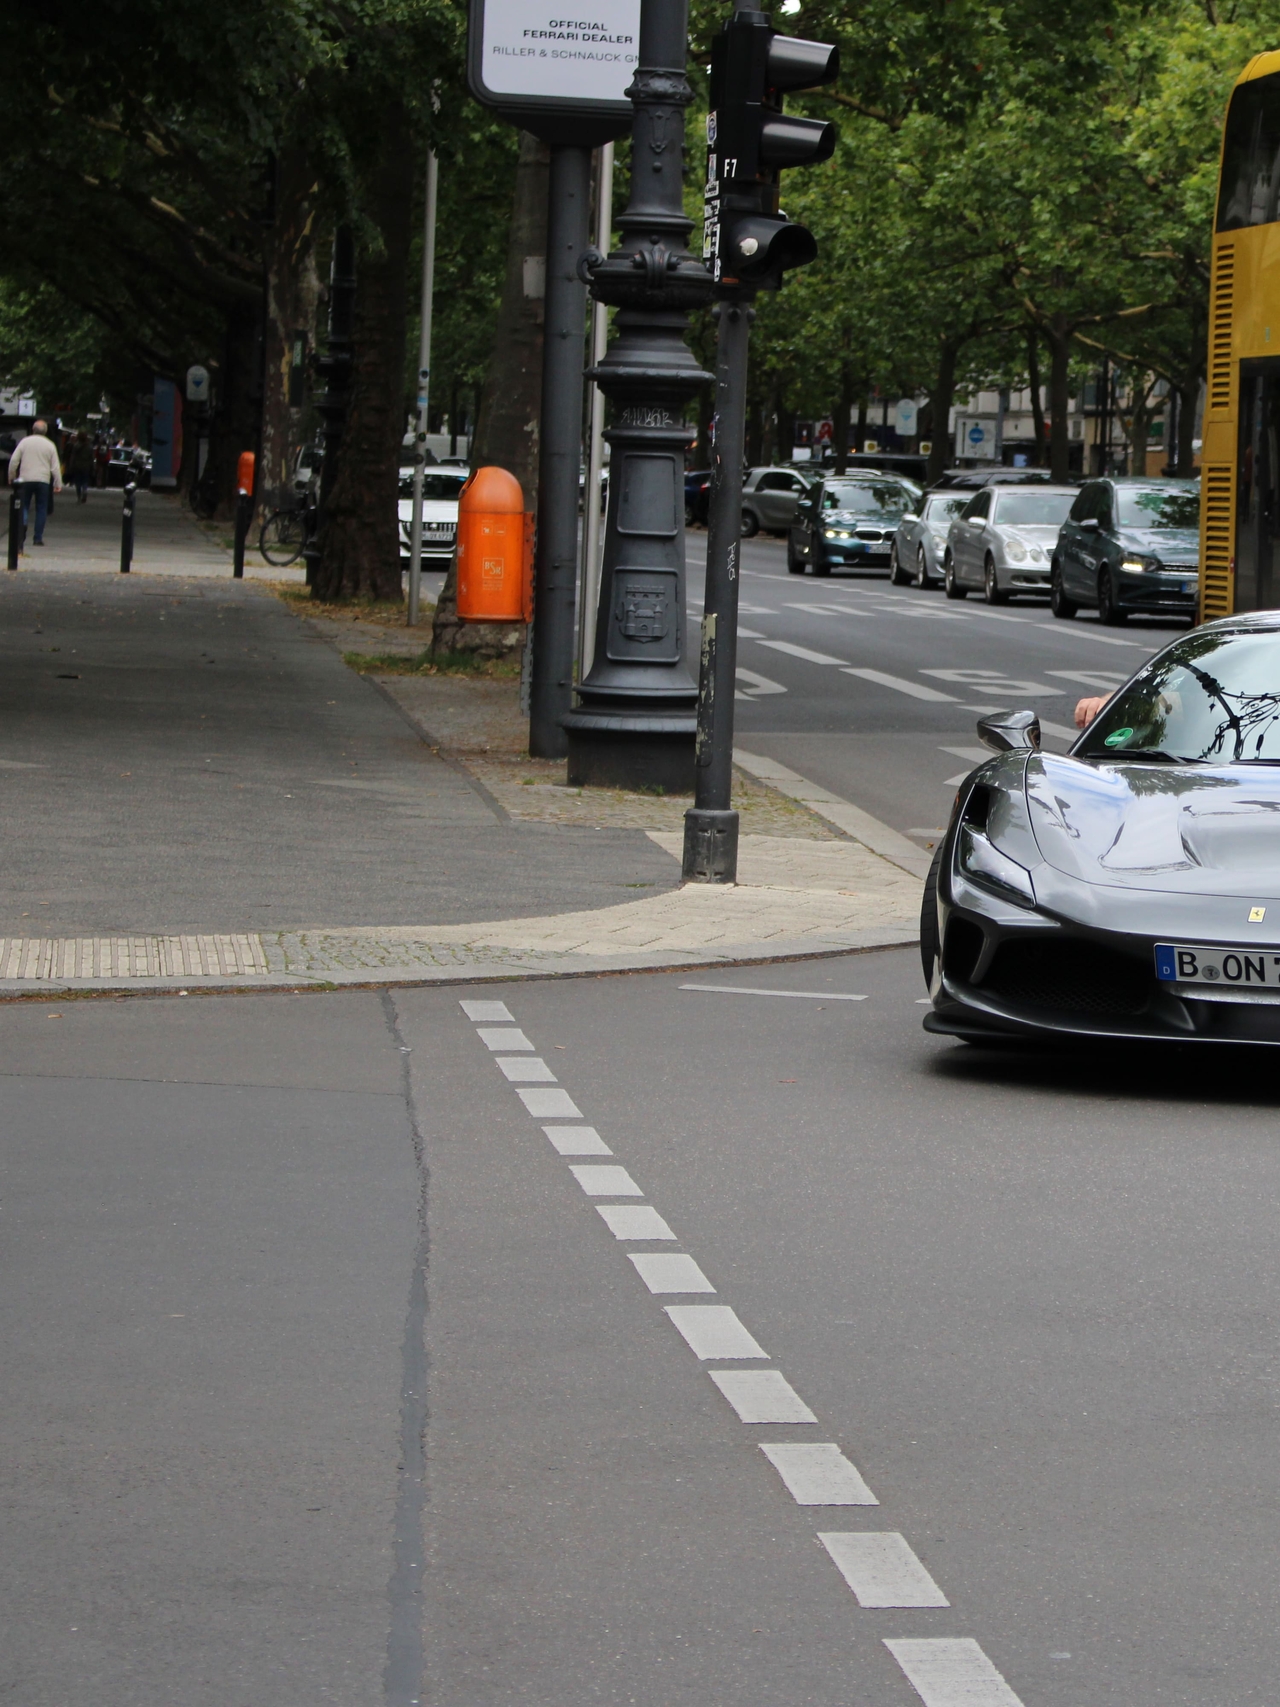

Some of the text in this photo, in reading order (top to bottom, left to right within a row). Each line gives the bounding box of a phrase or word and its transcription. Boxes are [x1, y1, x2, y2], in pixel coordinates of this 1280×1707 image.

[549, 20, 608, 31] OFFICIAL
[523, 29, 634, 44] FERRARI DEALER
[493, 46, 535, 57] RILLER
[539, 49, 547, 58] &
[551, 50, 621, 62] SCHNAUCK
[1163, 966, 1170, 974] D
[1178, 951, 1199, 977] B
[1222, 954, 1266, 982] ON
